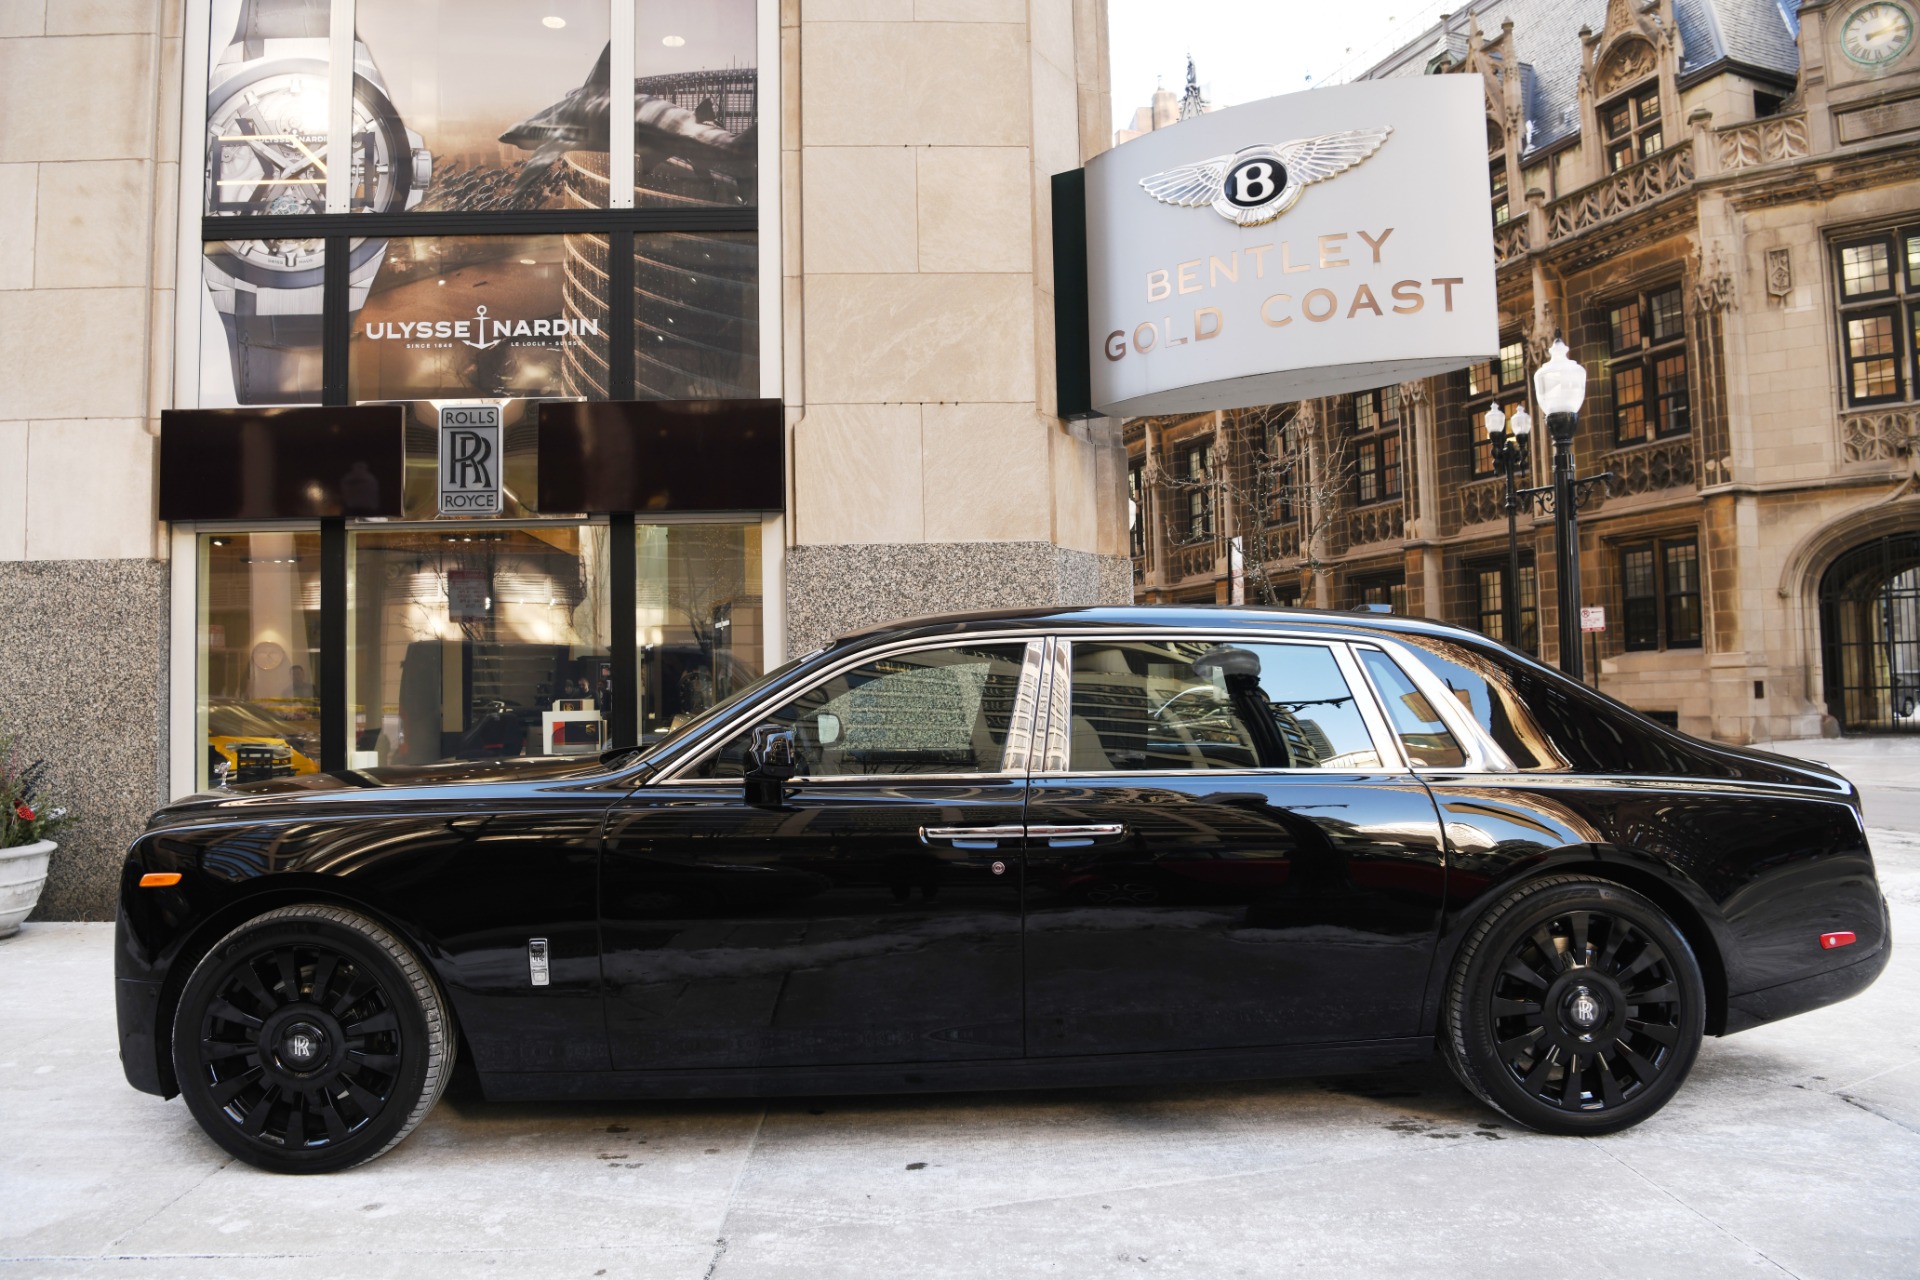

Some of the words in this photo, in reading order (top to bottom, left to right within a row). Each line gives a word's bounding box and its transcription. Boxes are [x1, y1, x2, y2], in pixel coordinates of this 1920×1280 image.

[298, 135, 328, 143] NARDI
[1233, 161, 1276, 203] B
[1146, 227, 1395, 304] BENTLEY
[366, 320, 471, 340] ULYSSE
[493, 318, 598, 338] NARDIN
[1104, 306, 1224, 362] GOLD
[1260, 276, 1464, 328] COAST
[446, 411, 495, 424] ROLLS
[445, 494, 494, 508] ROYCE
